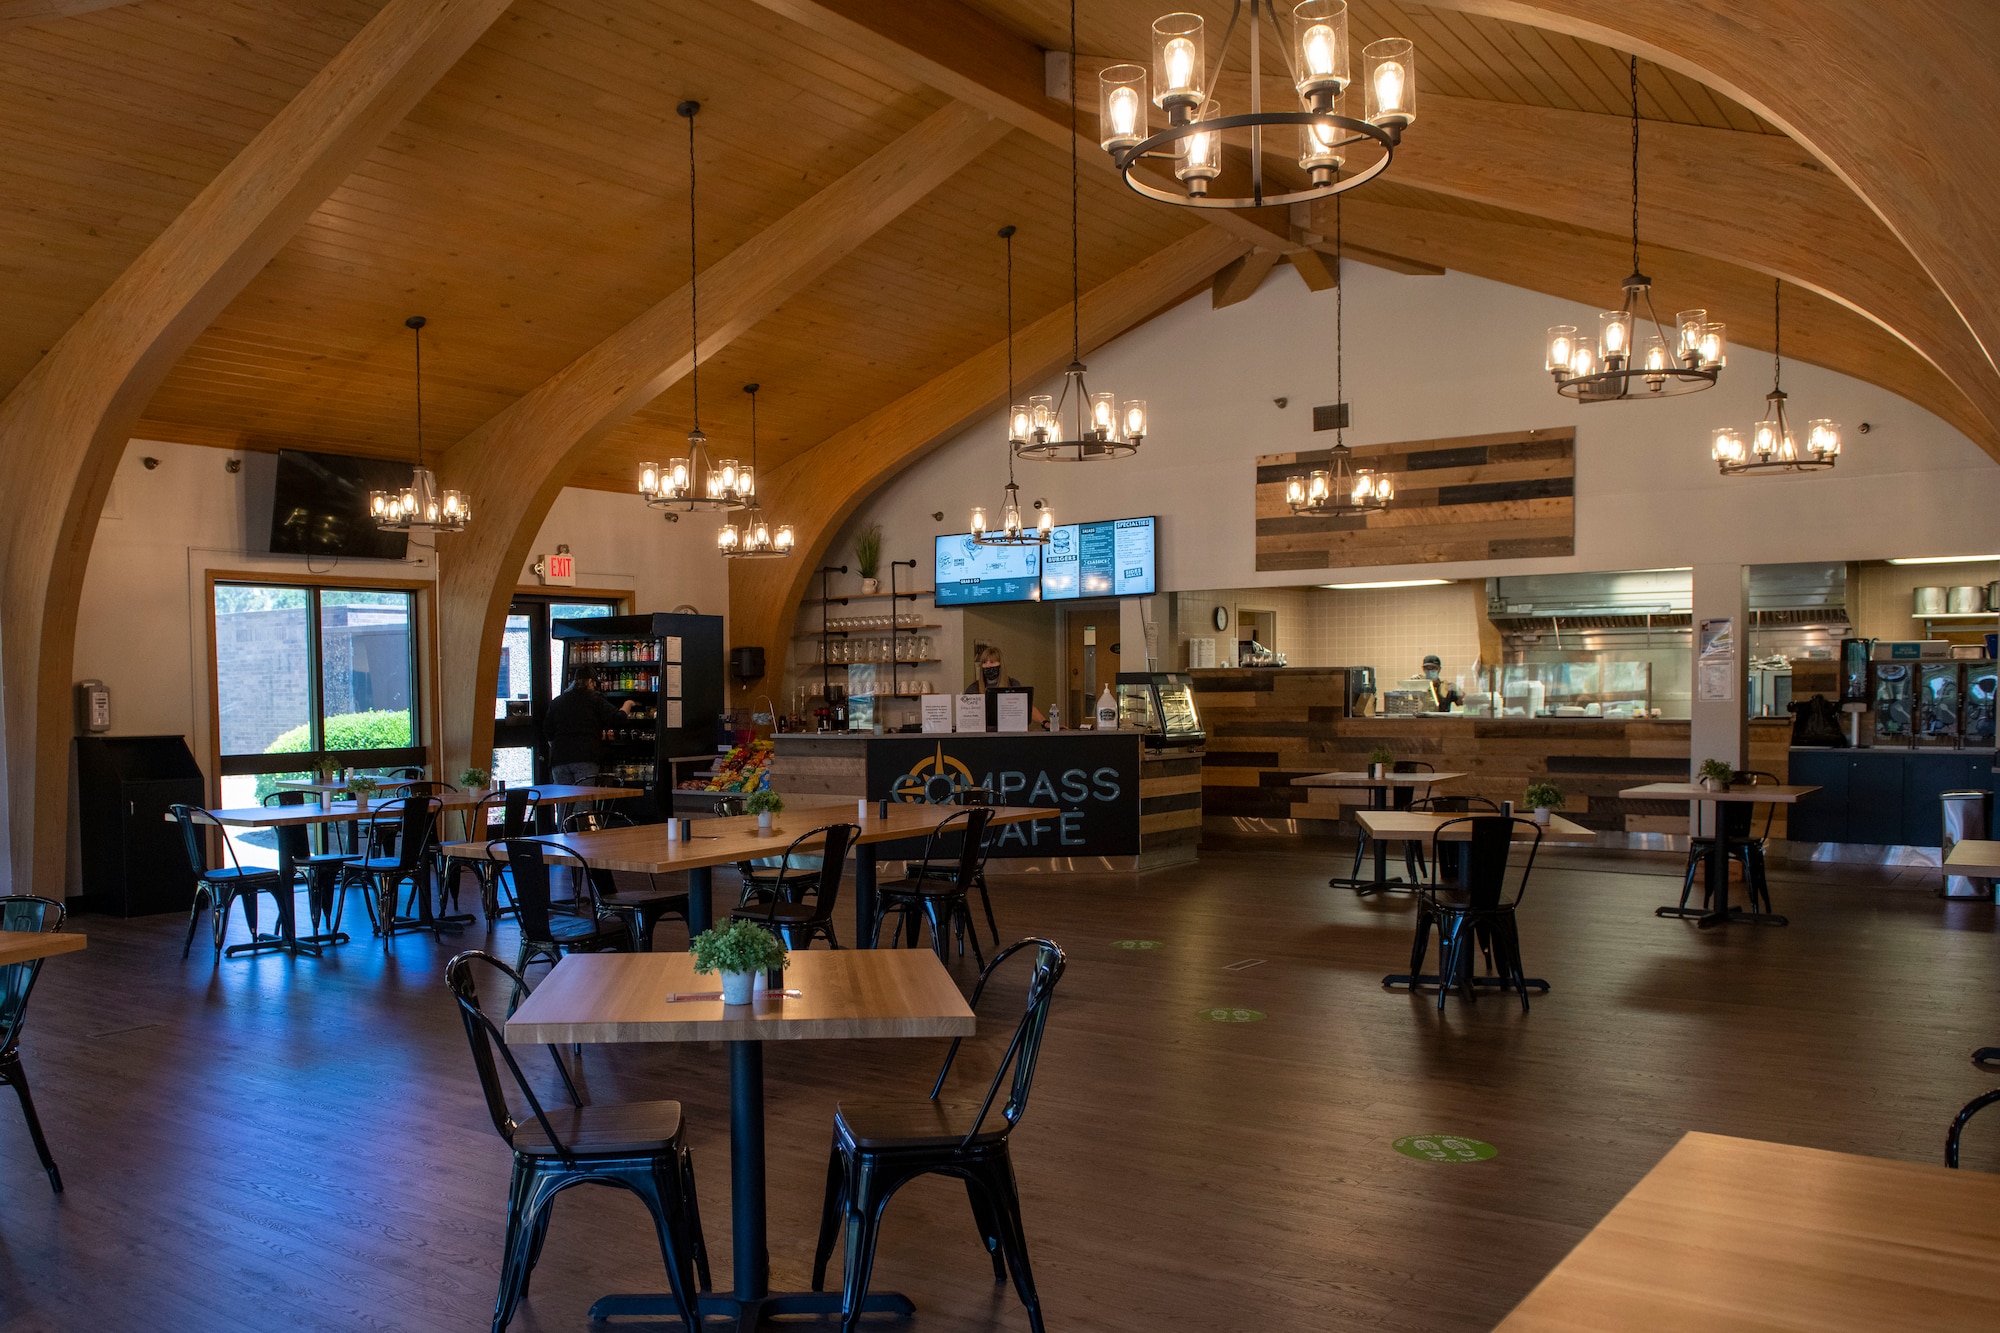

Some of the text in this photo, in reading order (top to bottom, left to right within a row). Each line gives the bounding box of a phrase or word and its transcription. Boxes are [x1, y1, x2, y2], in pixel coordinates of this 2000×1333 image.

[1117, 520, 1149, 529] SPECIALTIES
[551, 557, 571, 577] EXIT
[892, 767, 1121, 804] COMPASS
[979, 805, 1087, 848] AFÉ
